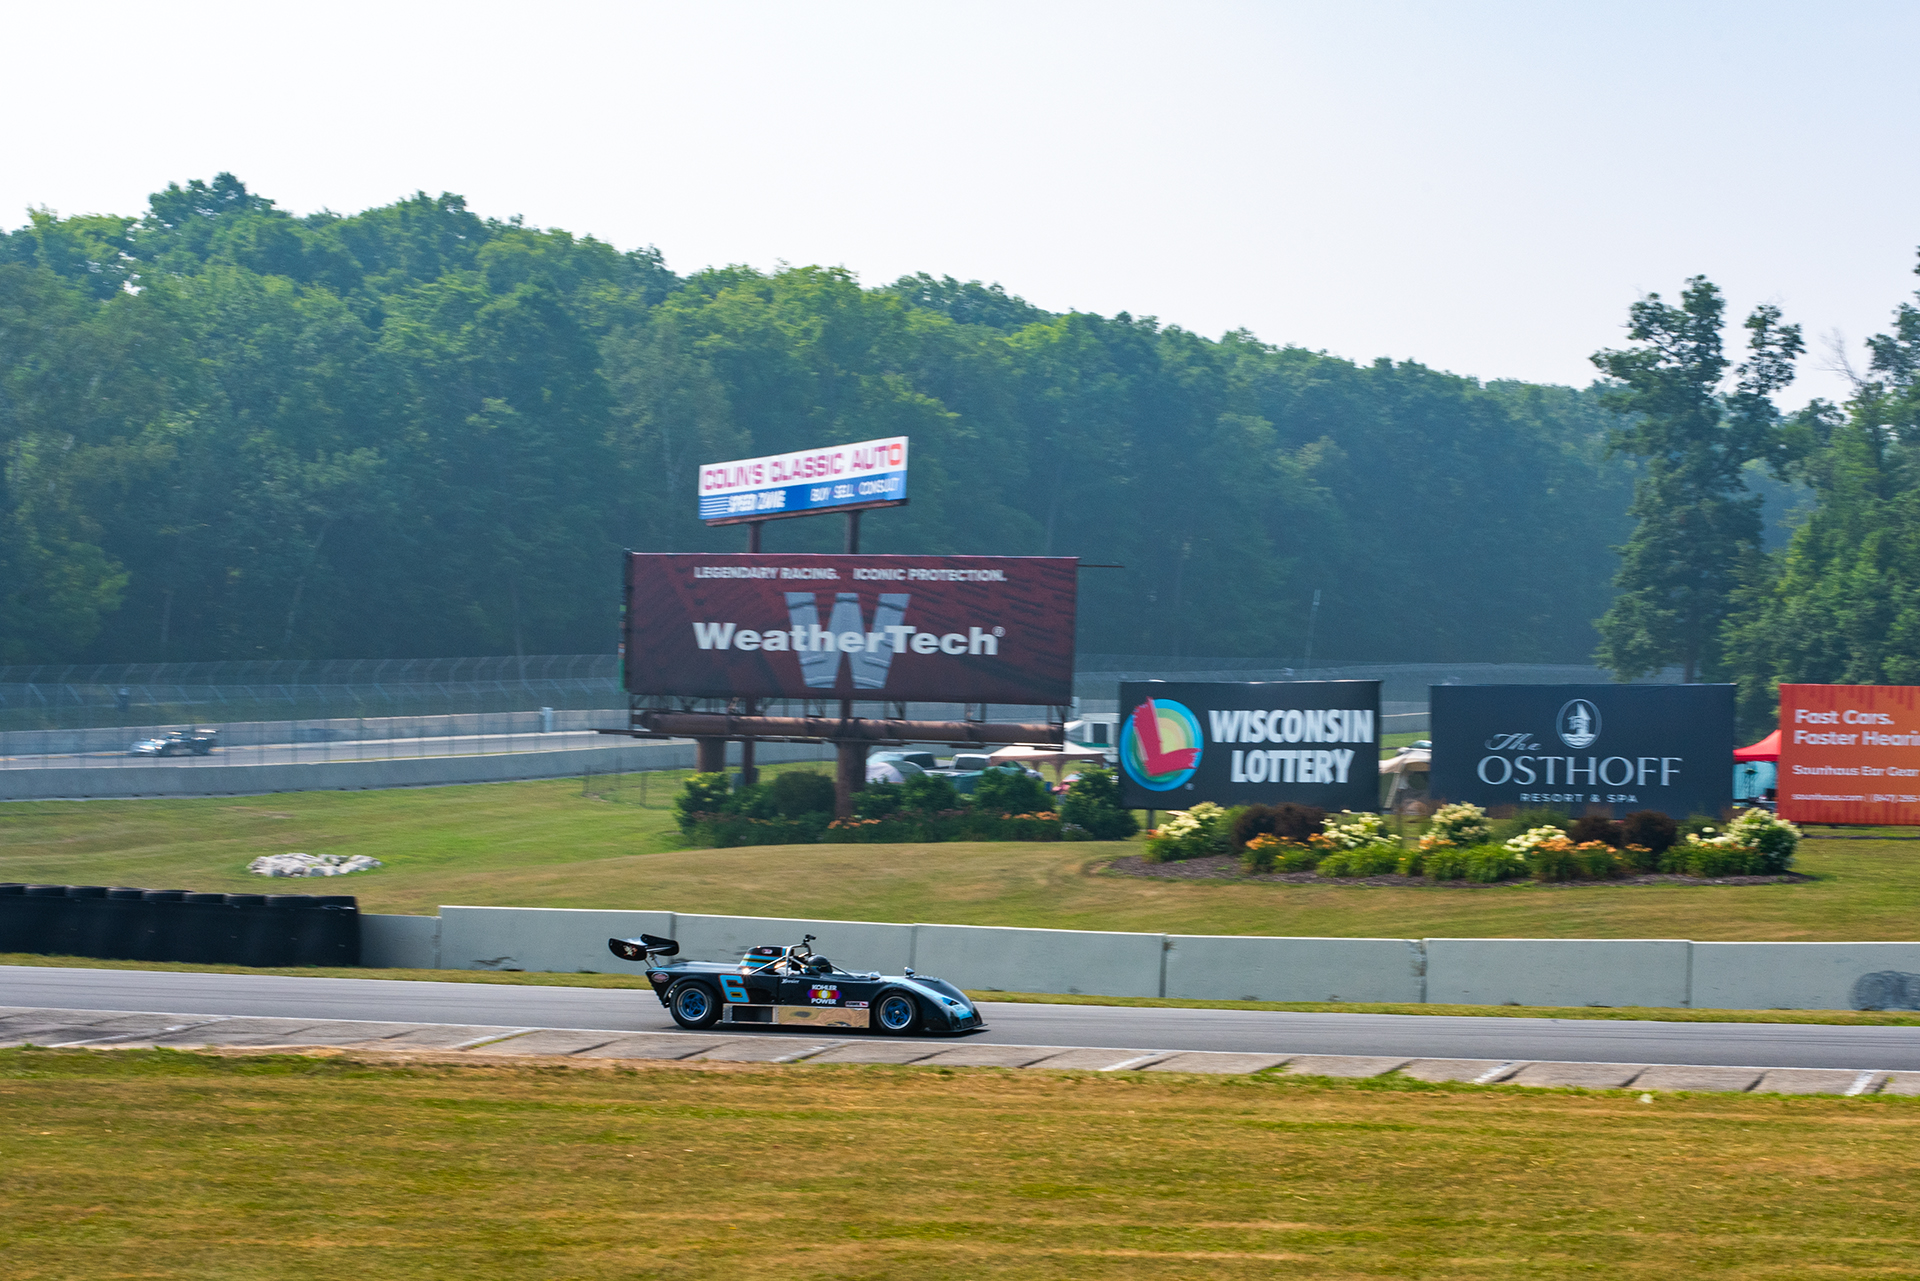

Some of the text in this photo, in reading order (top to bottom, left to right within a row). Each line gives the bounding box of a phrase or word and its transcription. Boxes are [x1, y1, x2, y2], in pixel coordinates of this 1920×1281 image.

[703, 443, 904, 491] COLIN'S CLASSIC AUTO
[810, 487, 832, 502] BUY
[833, 484, 855, 499] SELL
[694, 566, 840, 581] LEGENDARY RACING.
[853, 567, 1007, 582] ICONIC PROTECTION.
[1208, 708, 1375, 744] WISCONSIN
[1794, 709, 1895, 726] Fast Cars.
[1485, 733, 1542, 751] The
[1794, 730, 1859, 745] Faster
[1230, 748, 1356, 785] LOTTERY
[1476, 755, 1684, 787] OSTHOFF
[1861, 766, 1885, 776] Ear
[1519, 792, 1639, 804] RESORT & SPA
[718, 974, 751, 1004] 6
